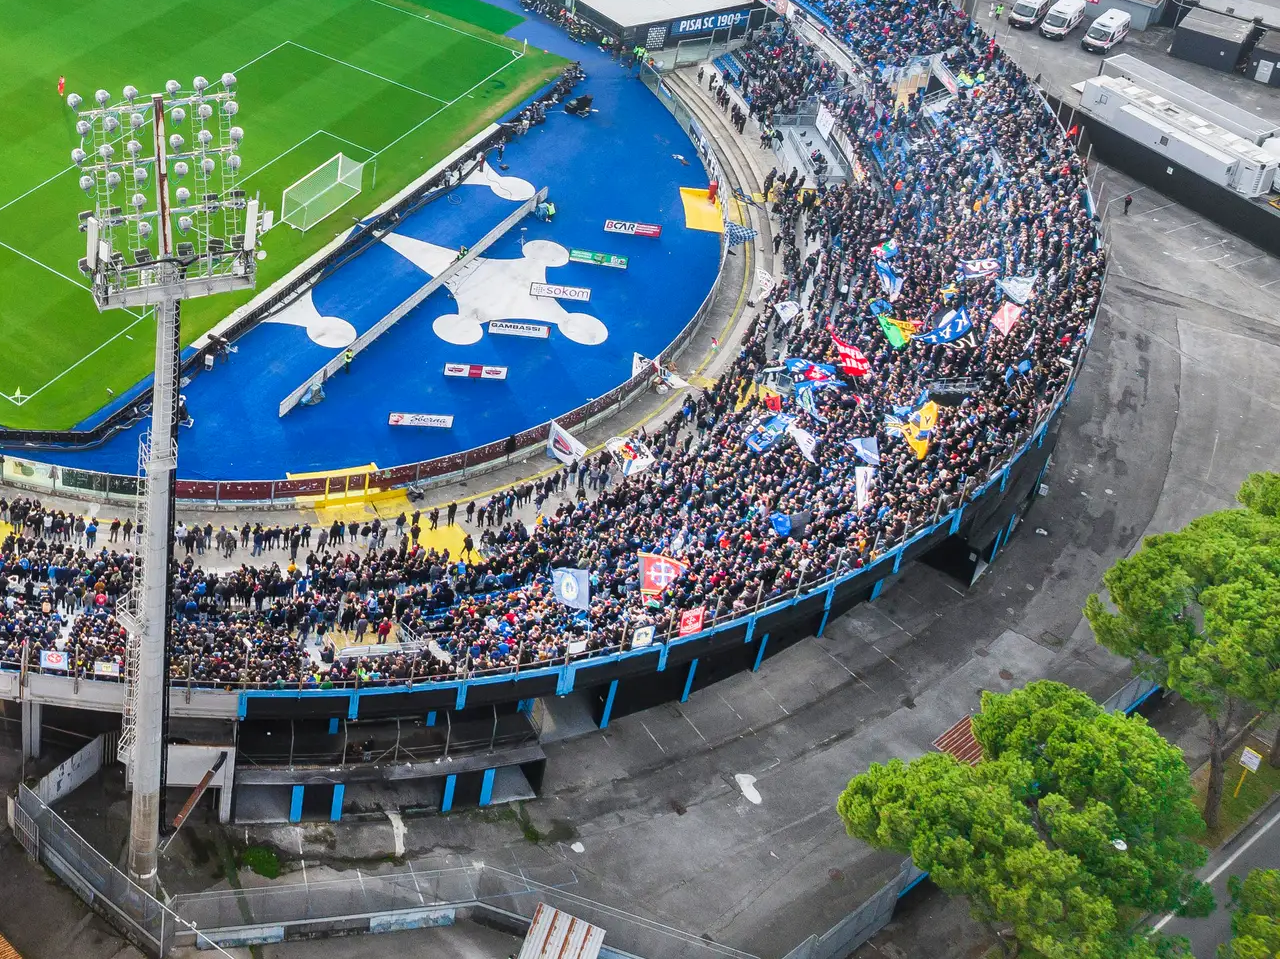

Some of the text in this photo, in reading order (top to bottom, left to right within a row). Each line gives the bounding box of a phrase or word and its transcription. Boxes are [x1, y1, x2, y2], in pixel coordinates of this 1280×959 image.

[680, 13, 741, 32] PISA SC 1909
[606, 221, 635, 232] BCAR
[546, 286, 589, 299] sokom
[491, 321, 541, 332] GAMBASSI
